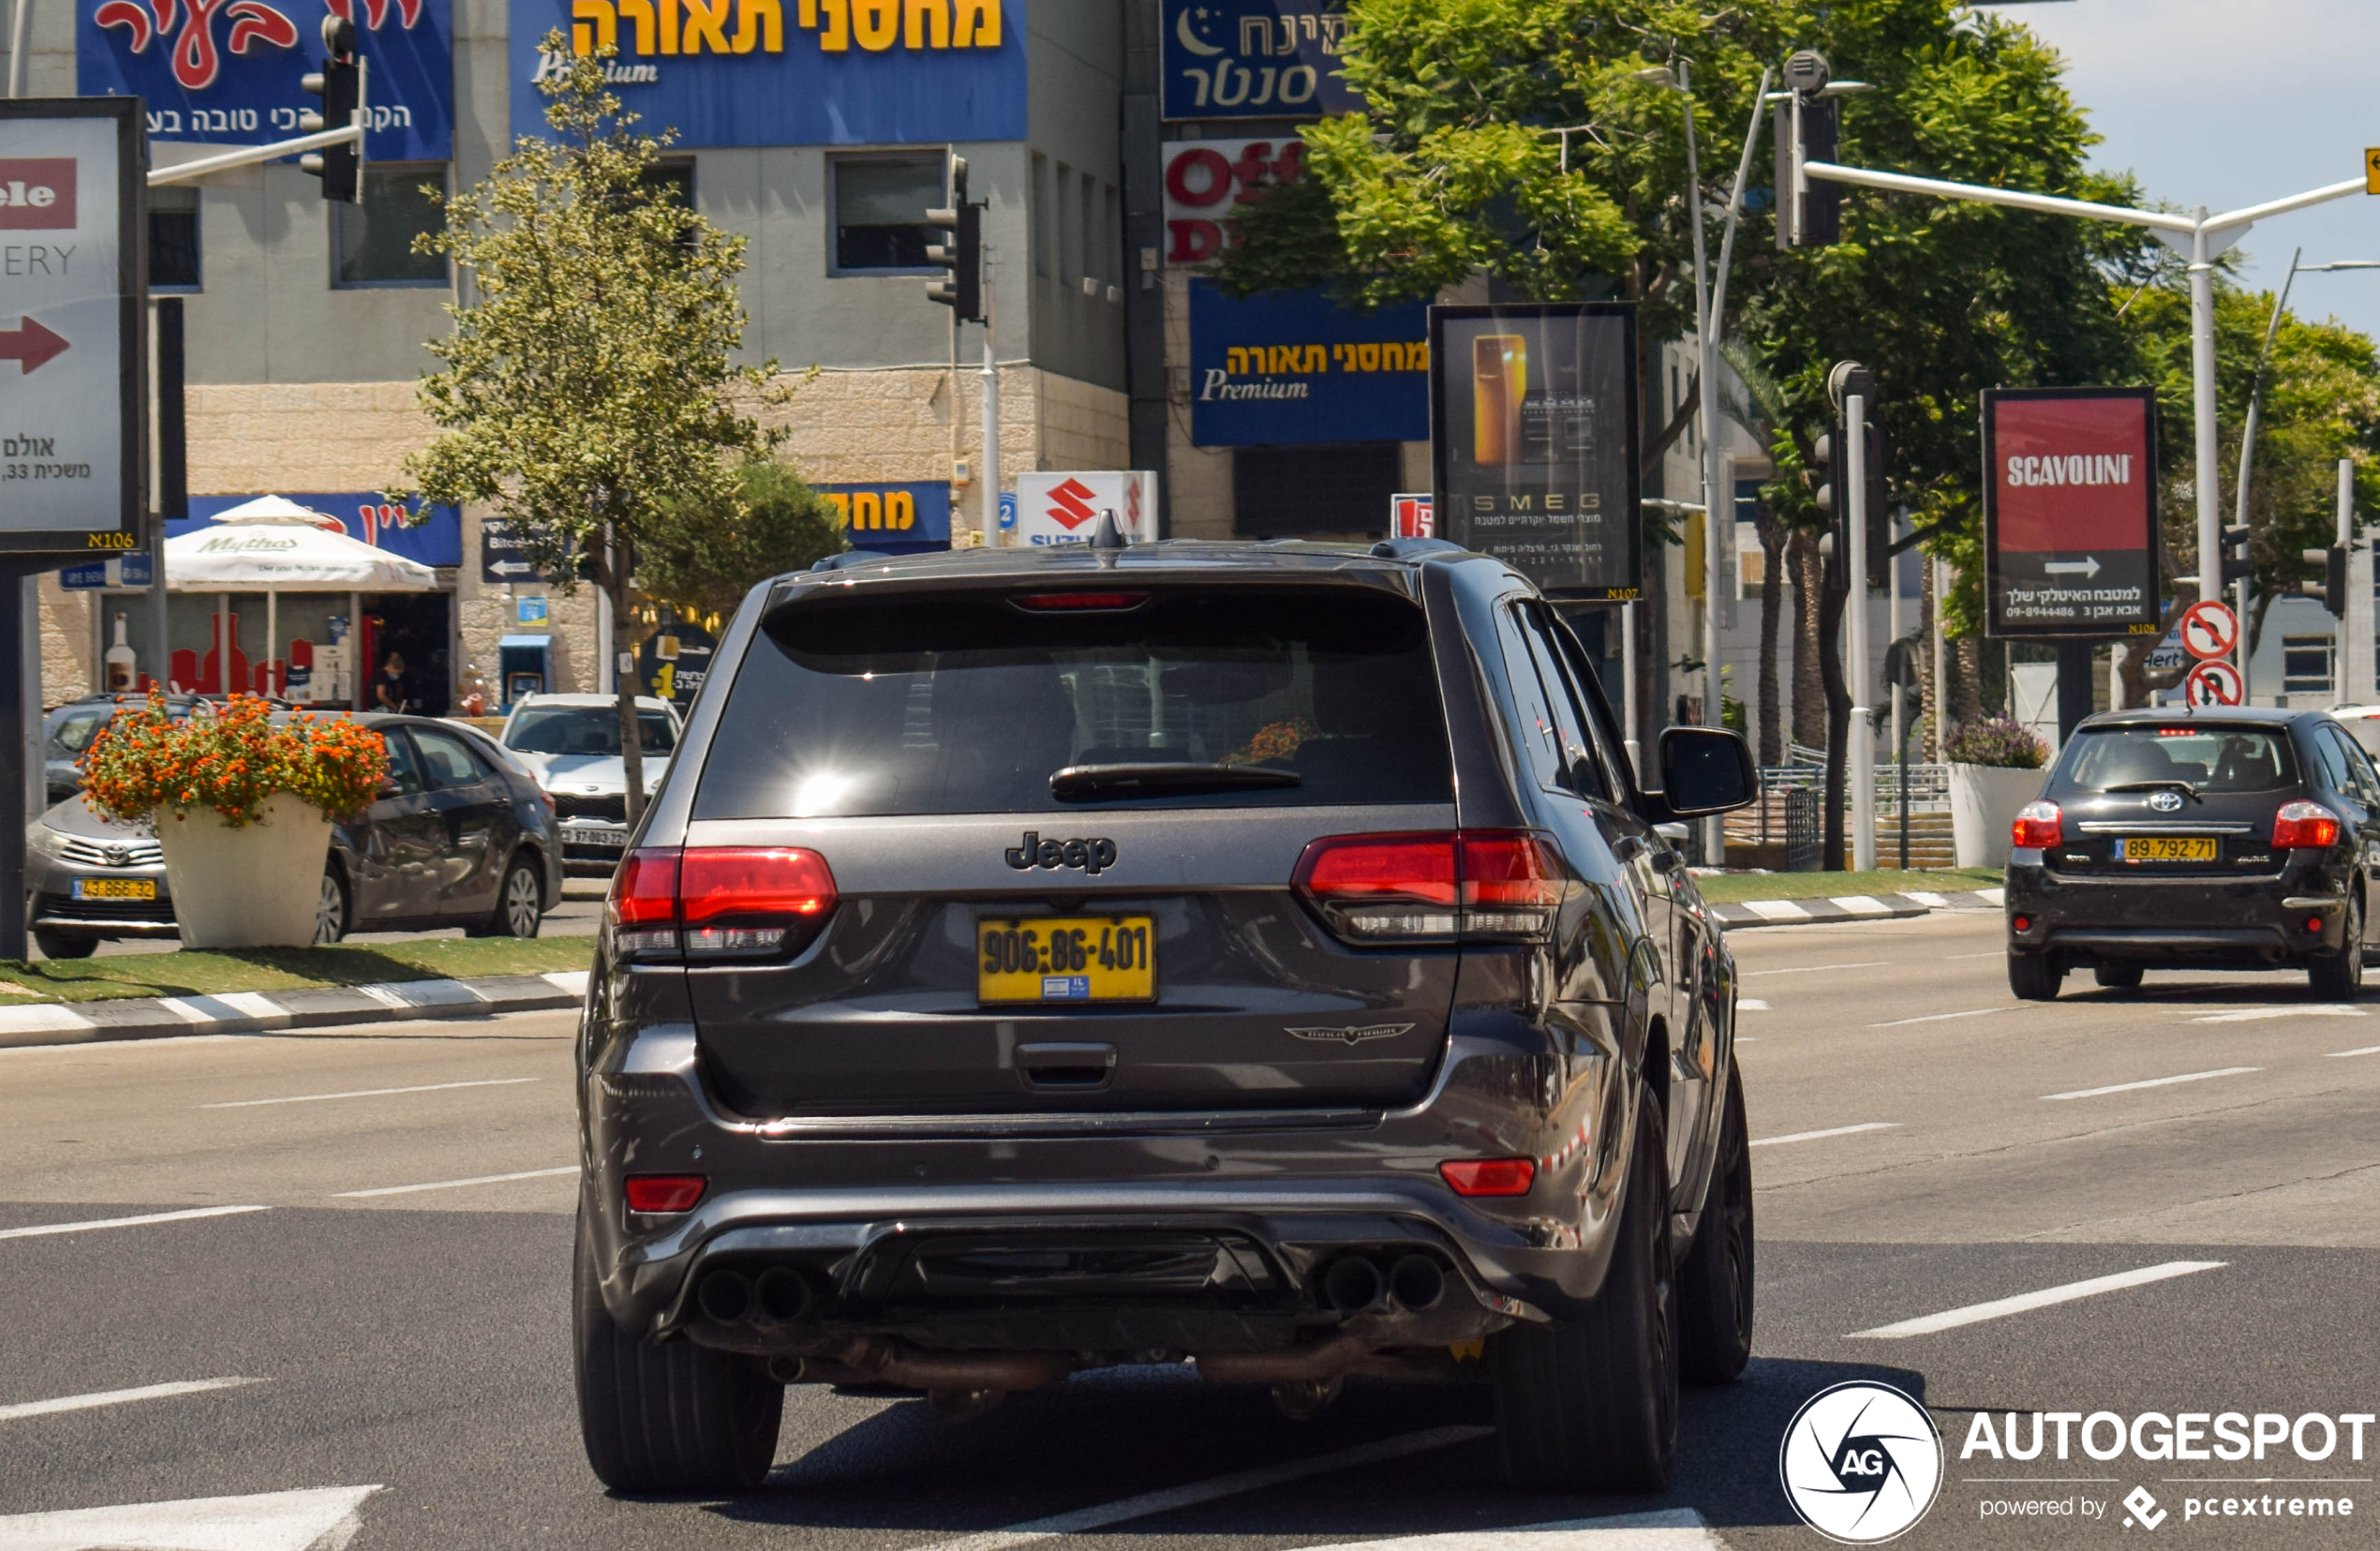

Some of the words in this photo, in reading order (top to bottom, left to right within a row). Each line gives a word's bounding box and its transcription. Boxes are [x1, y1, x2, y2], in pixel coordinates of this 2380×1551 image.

[572, 0, 782, 55] תאורה
[799, 0, 1002, 52] מחסני
[530, 49, 660, 83] Prium
[1183, 59, 1316, 107] סנטר
[191, 110, 258, 132] טובה
[1166, 142, 1308, 207] Off
[5, 246, 77, 275] ERY
[1227, 344, 1327, 375] תאורה
[1333, 341, 1429, 372] מחסני
[1198, 368, 1309, 401] Premium
[3, 432, 54, 457] אולם
[35, 463, 91, 480] משכית
[2007, 454, 2131, 486] SCAVOLINI
[1474, 493, 1600, 511] SMEG
[1474, 515, 1506, 526] למטבח
[1547, 514, 1574, 524] חשמל
[196, 536, 298, 553] Mythos
[2006, 589, 2034, 605] שלך
[2037, 588, 2092, 604] האיטלקי
[2093, 586, 2141, 602] למטבח
[2083, 606, 2090, 617] 3
[2116, 605, 2141, 616] אבא
[1005, 831, 1117, 875] Jeep
[1073, 977, 1084, 986] IL
